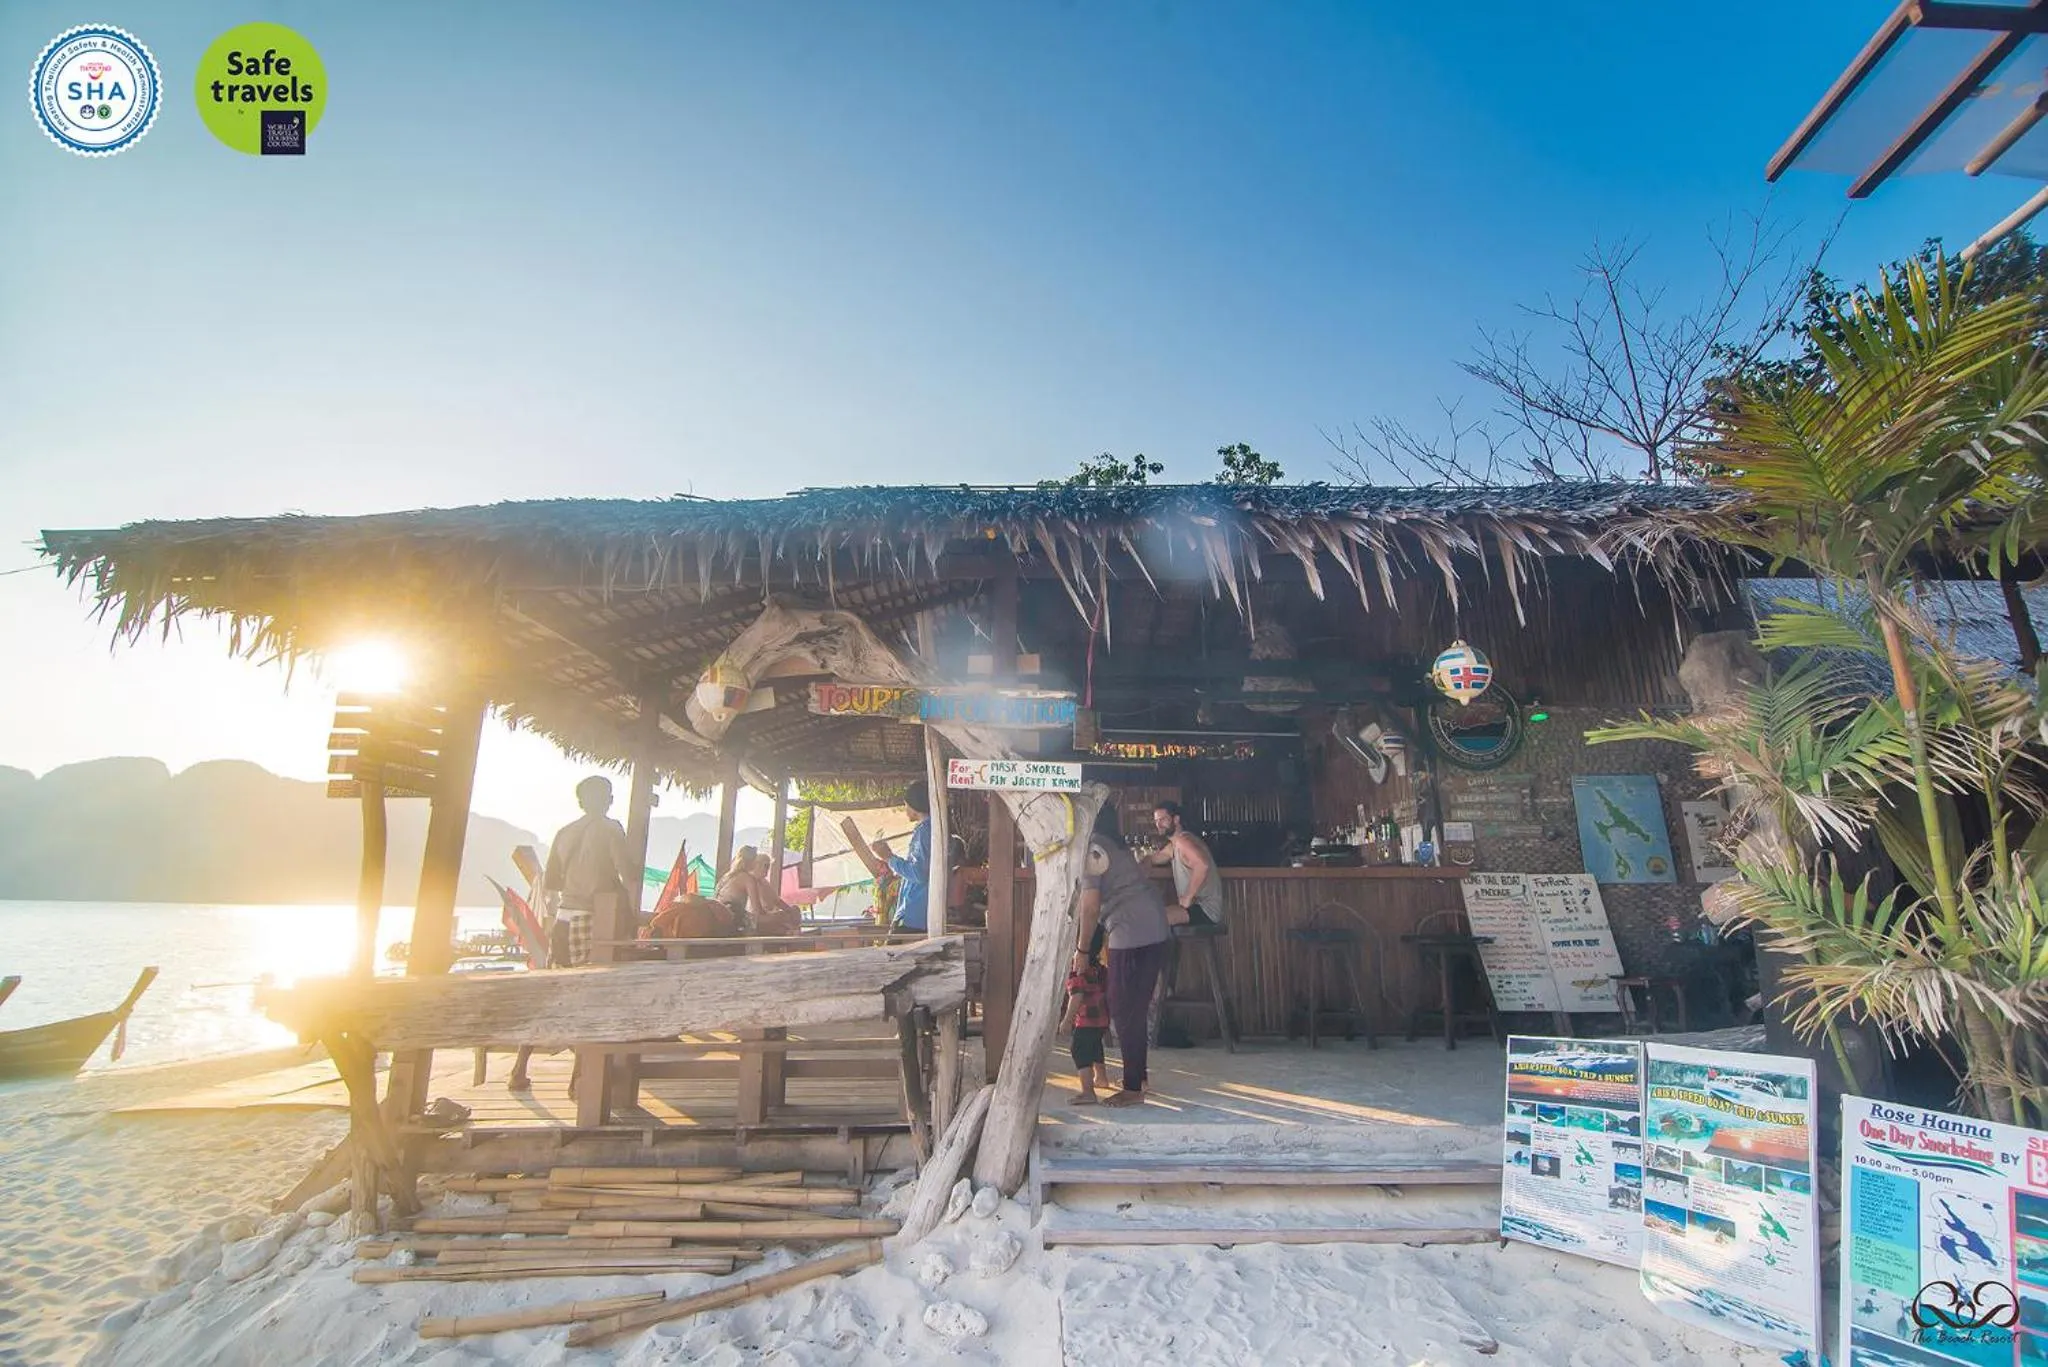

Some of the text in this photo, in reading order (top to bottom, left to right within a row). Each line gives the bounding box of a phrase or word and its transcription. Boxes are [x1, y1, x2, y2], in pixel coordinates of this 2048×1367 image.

[950, 761, 970, 773] For
[990, 762, 1066, 775] MASK SNORKEL
[951, 774, 975, 785] Rent
[989, 775, 1081, 789] FIN JACKET KAYAK
[1559, 1066, 1578, 1077] BOAT
[1579, 1070, 1597, 1080] TRIP
[1604, 1073, 1635, 1083] SUNSET
[1678, 1089, 1706, 1105] SPEED
[1707, 1094, 1732, 1113] BOAT
[1734, 1103, 1757, 1120] TRIP
[1765, 1110, 1805, 1126] SUNSET
[1871, 1103, 1992, 1139] Rose Hanna
[1860, 1119, 1996, 1167] One Day Snorkeling
[2001, 1152, 2020, 1166] BY
[1885, 1163, 1902, 1172] am
[1912, 1168, 1953, 1184] 5.00pm
